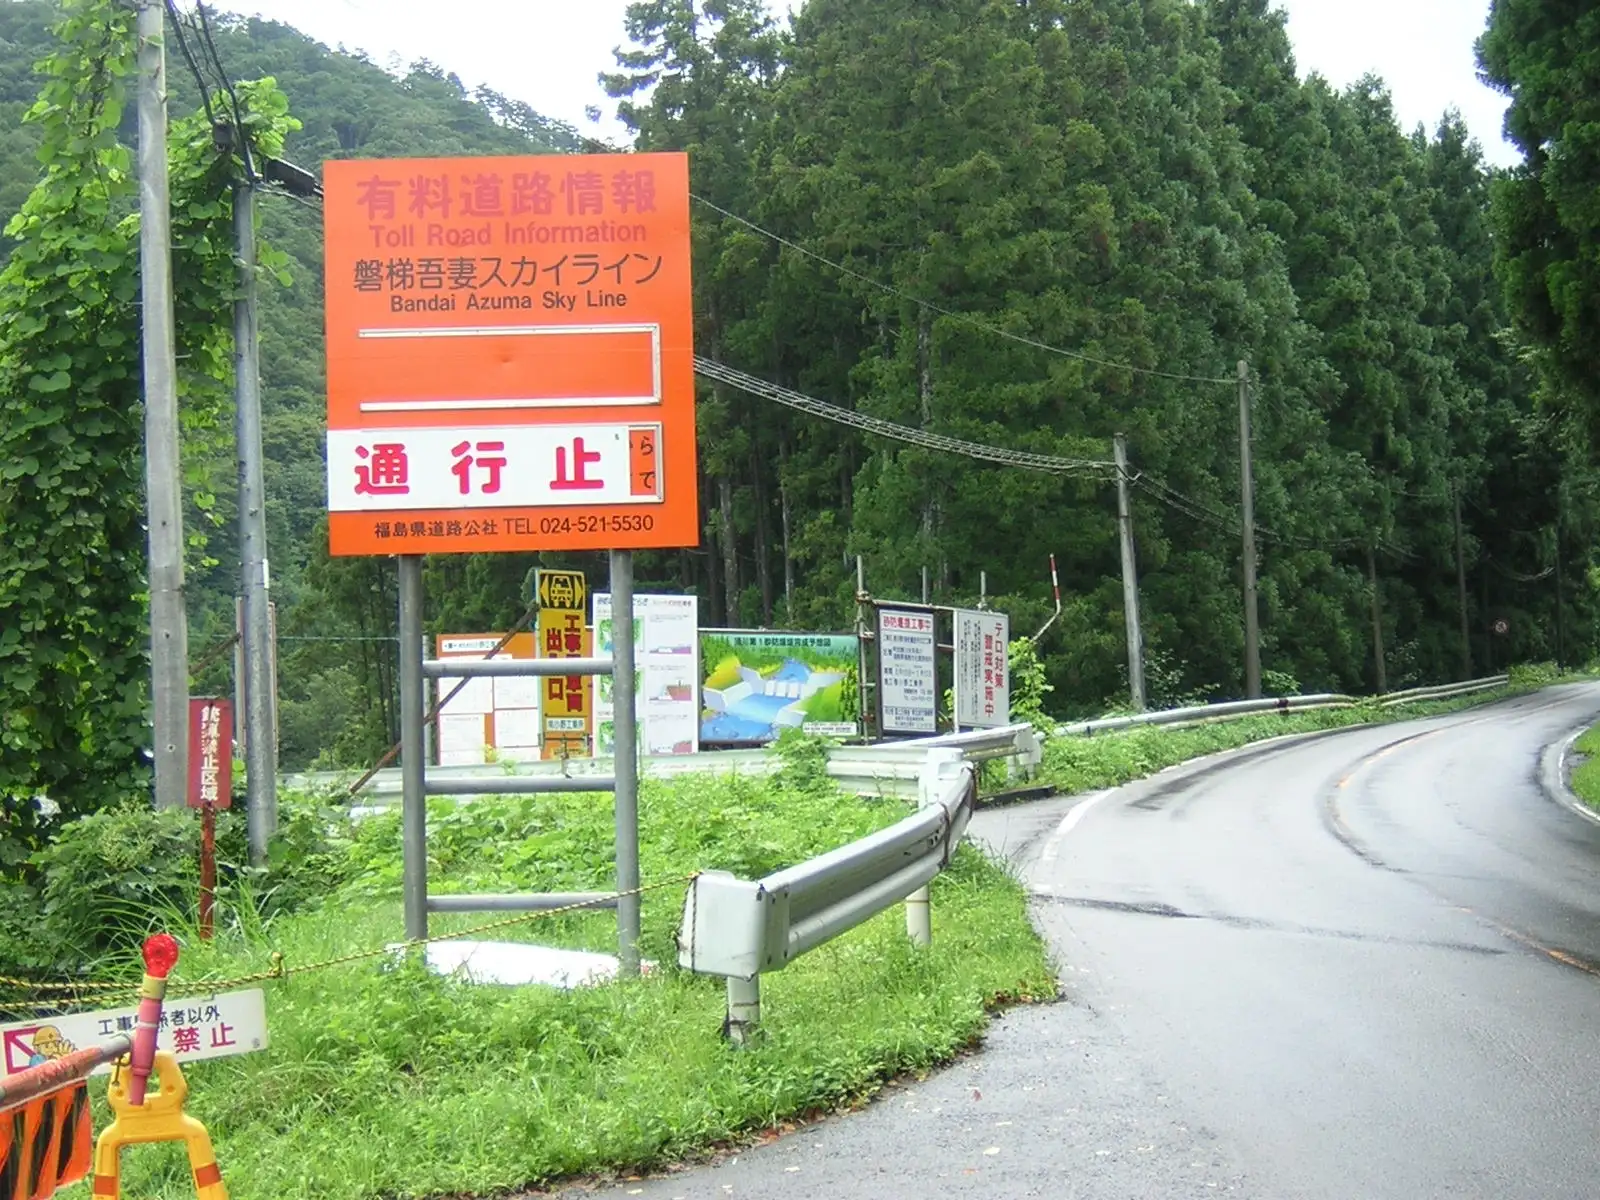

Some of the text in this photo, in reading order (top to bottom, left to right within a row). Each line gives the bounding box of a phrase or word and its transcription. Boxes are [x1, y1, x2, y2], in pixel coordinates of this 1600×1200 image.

[356, 169, 657, 220] 有料道路情報
[369, 220, 647, 248] Toll Road Information
[353, 253, 662, 293] 磐梯吾妻スカイライン
[390, 290, 627, 312] Bandai Azuma Sky Line
[354, 436, 604, 496] 通行止
[374, 514, 654, 539] 福島県道路公社 TEL 024-521-5530
[546, 627, 563, 701] 出口
[97, 1003, 221, 1036] 工事係者以外
[157, 1021, 236, 1054] 禁止
